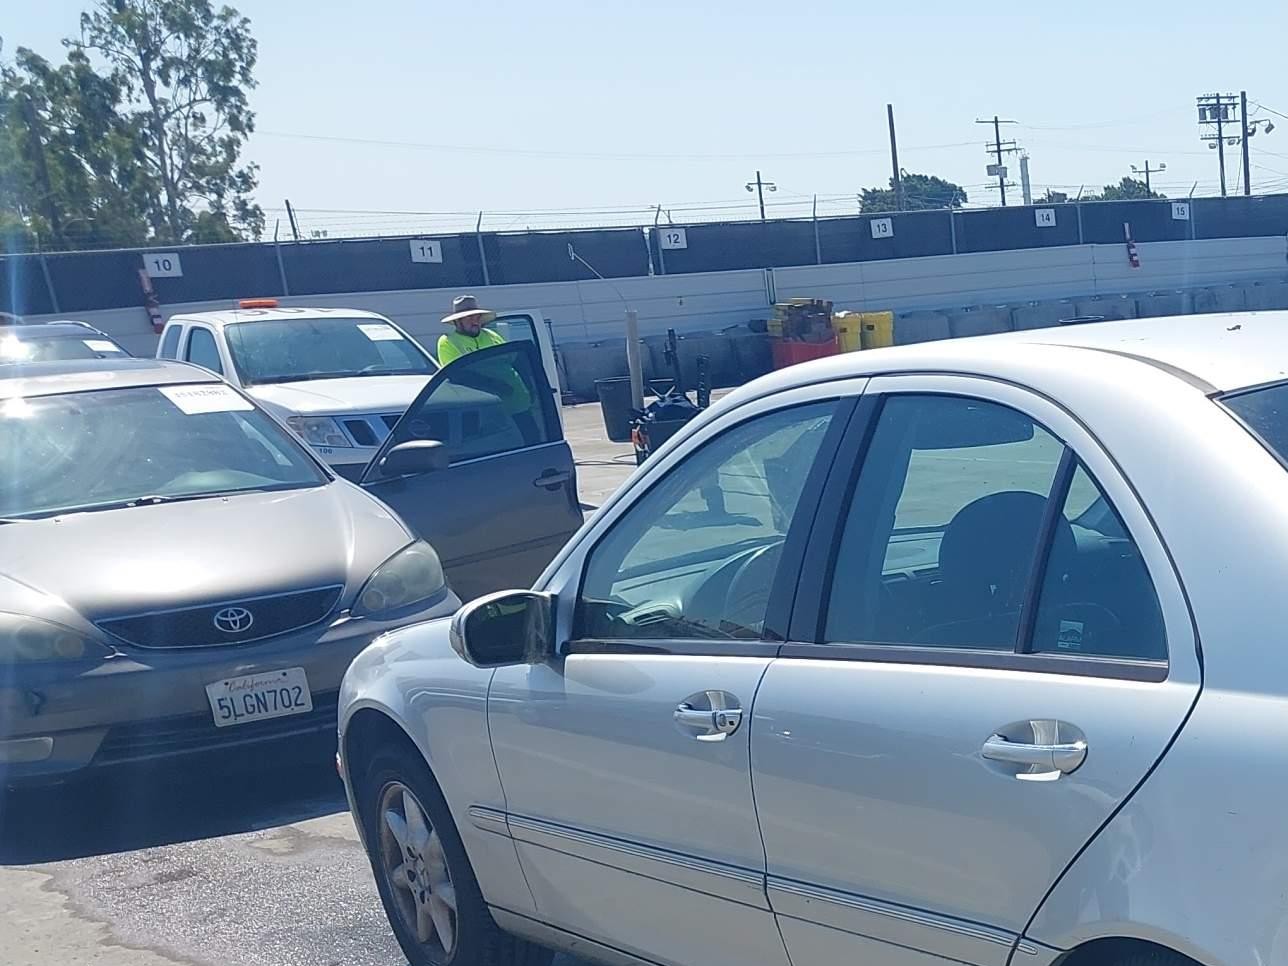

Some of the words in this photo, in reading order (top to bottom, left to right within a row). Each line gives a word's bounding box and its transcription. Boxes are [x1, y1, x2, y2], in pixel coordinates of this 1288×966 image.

[1176, 206, 1185, 216] 15
[1041, 213, 1051, 223] 14
[877, 223, 888, 234] 13
[666, 233, 680, 244] 12
[419, 246, 434, 258] 11
[154, 259, 172, 272] 10
[217, 686, 306, 720] 5LGN702
